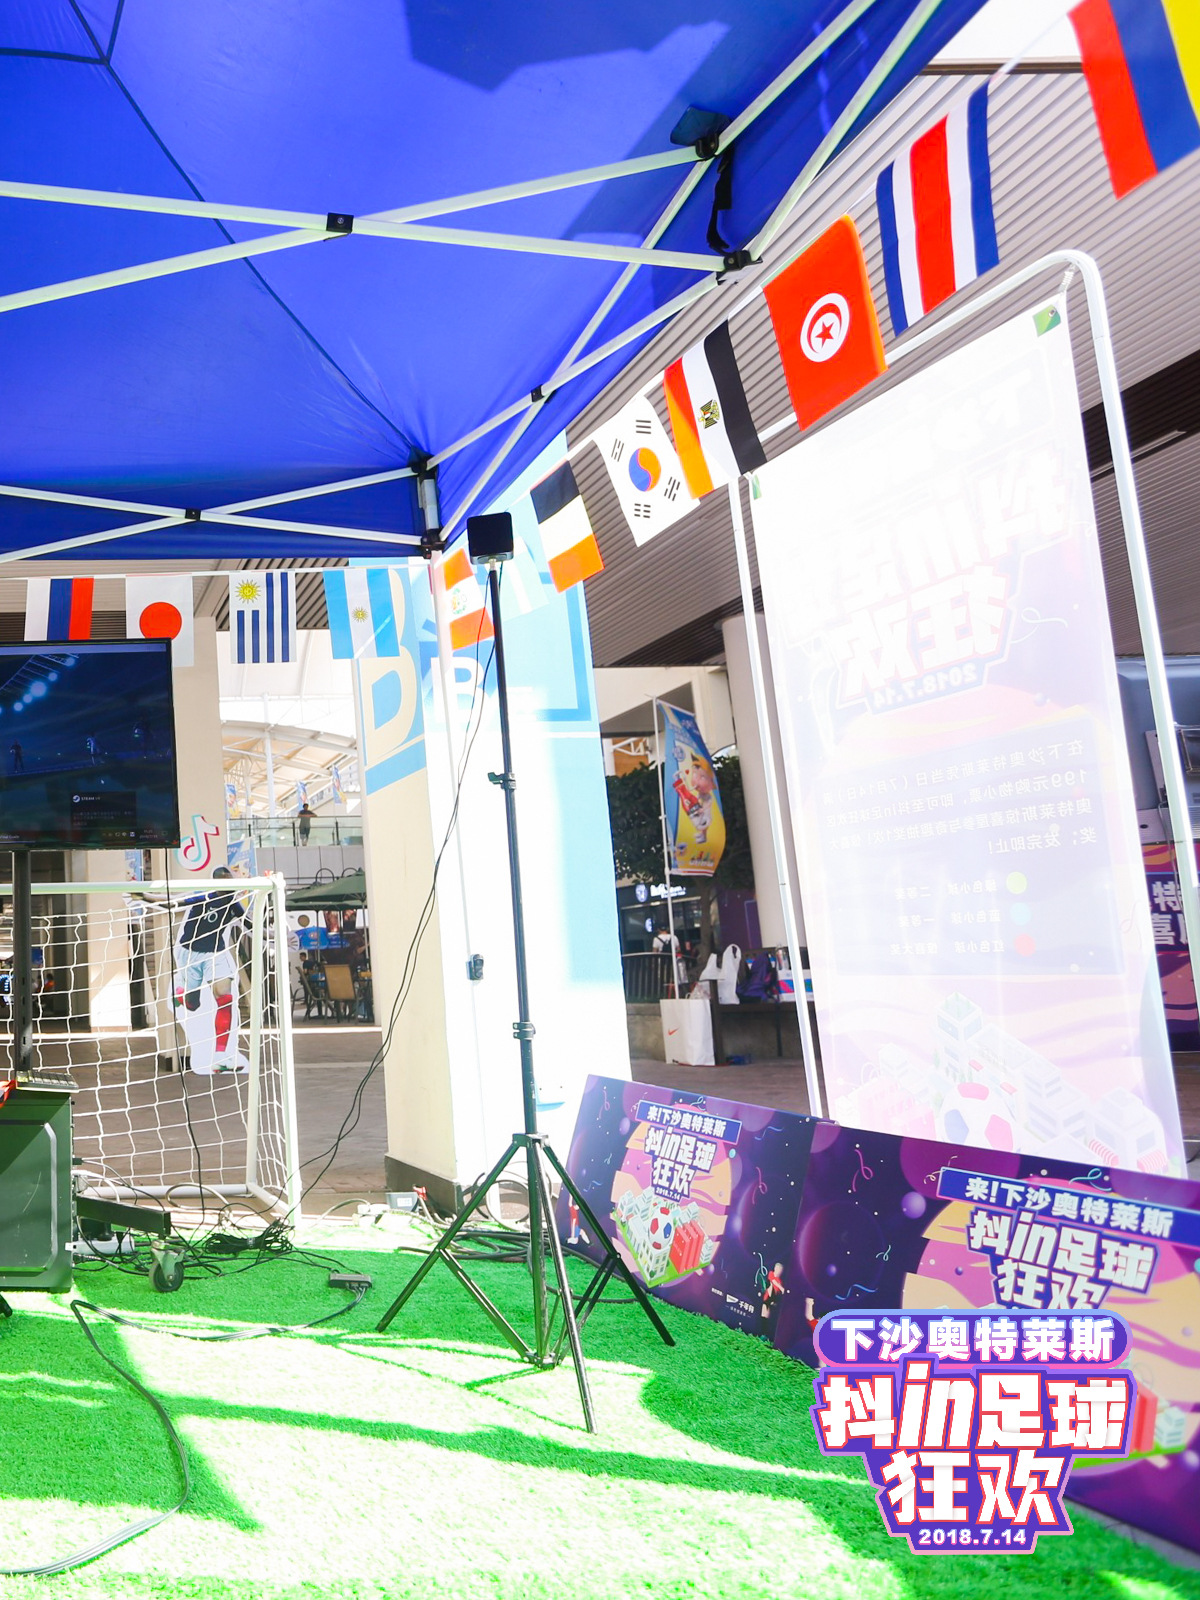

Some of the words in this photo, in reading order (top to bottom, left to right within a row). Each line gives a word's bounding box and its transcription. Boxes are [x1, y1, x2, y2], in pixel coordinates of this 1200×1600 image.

[644, 1126, 718, 1171] 抖in足球
[652, 1157, 696, 1196] 狂欢
[969, 1210, 1155, 1291] 抖in足球
[997, 1258, 1107, 1309] 狂欢
